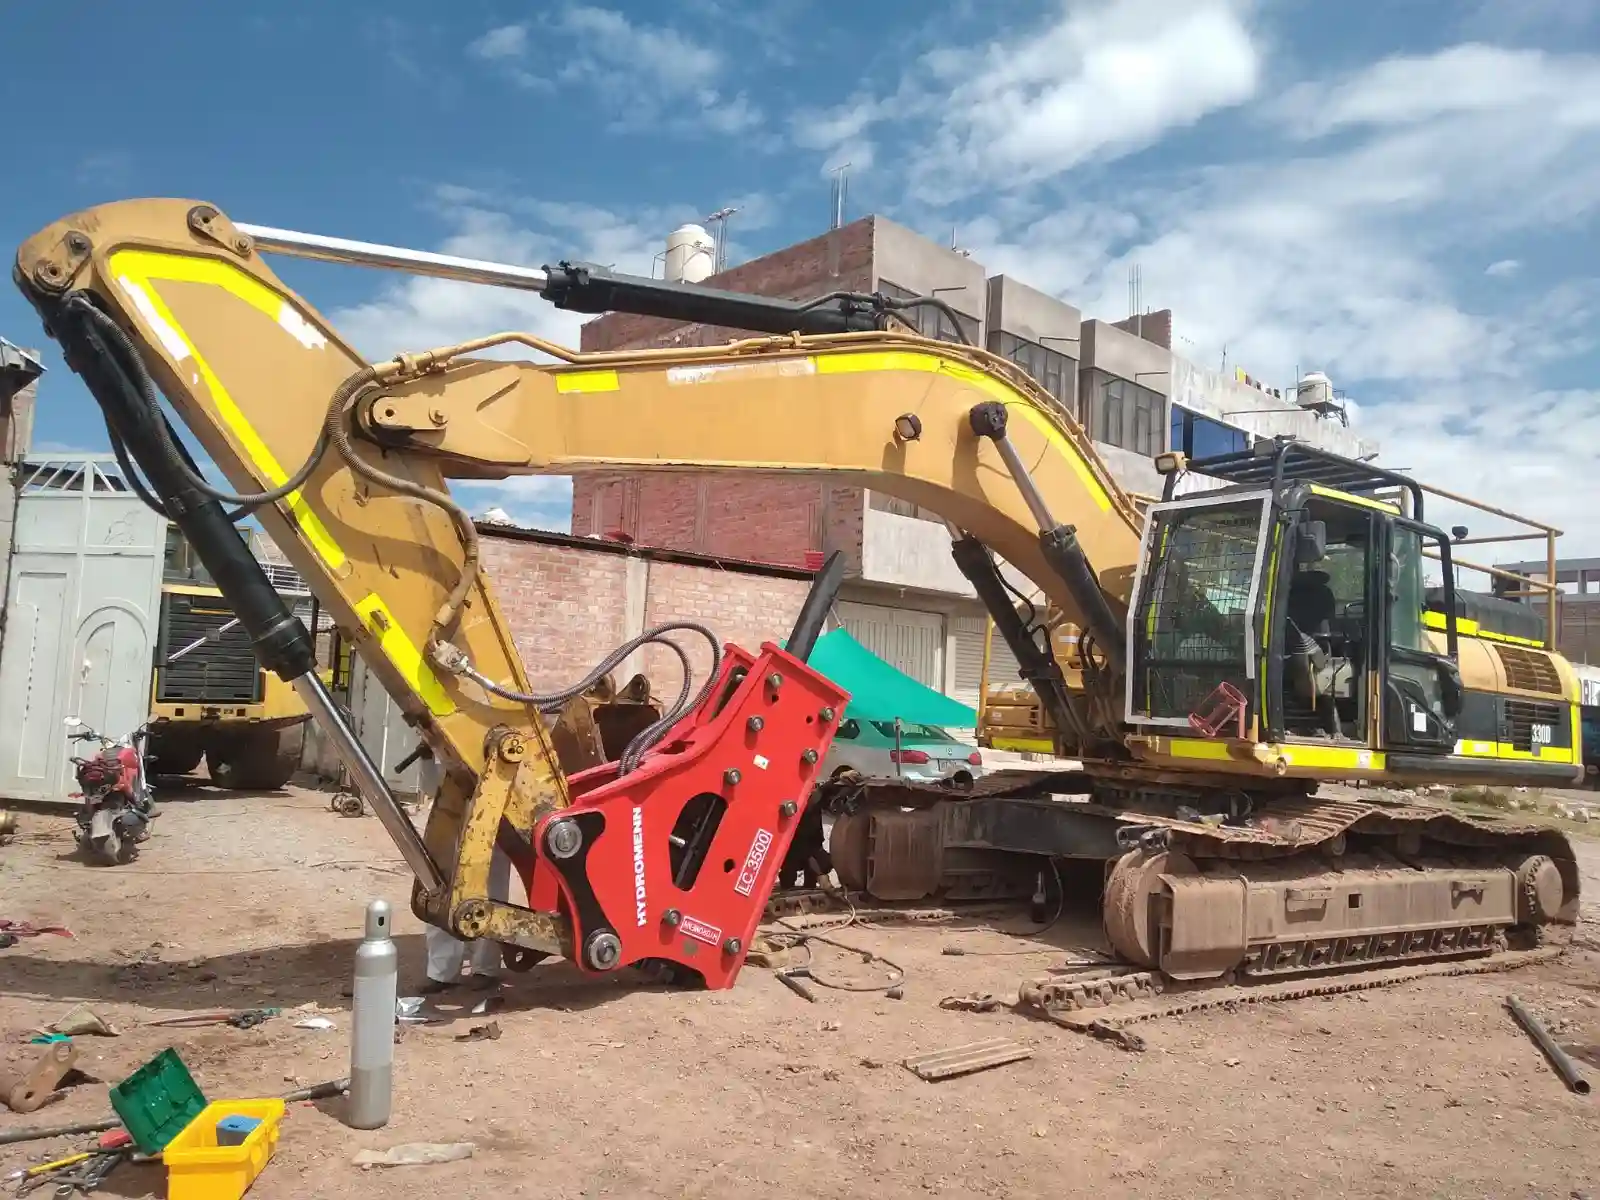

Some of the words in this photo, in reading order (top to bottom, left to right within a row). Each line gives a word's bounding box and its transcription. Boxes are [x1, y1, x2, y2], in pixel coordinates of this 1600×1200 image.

[632, 807, 647, 927] HYDROMENN
[738, 872, 753, 892] LC
[748, 833, 769, 870] 3500
